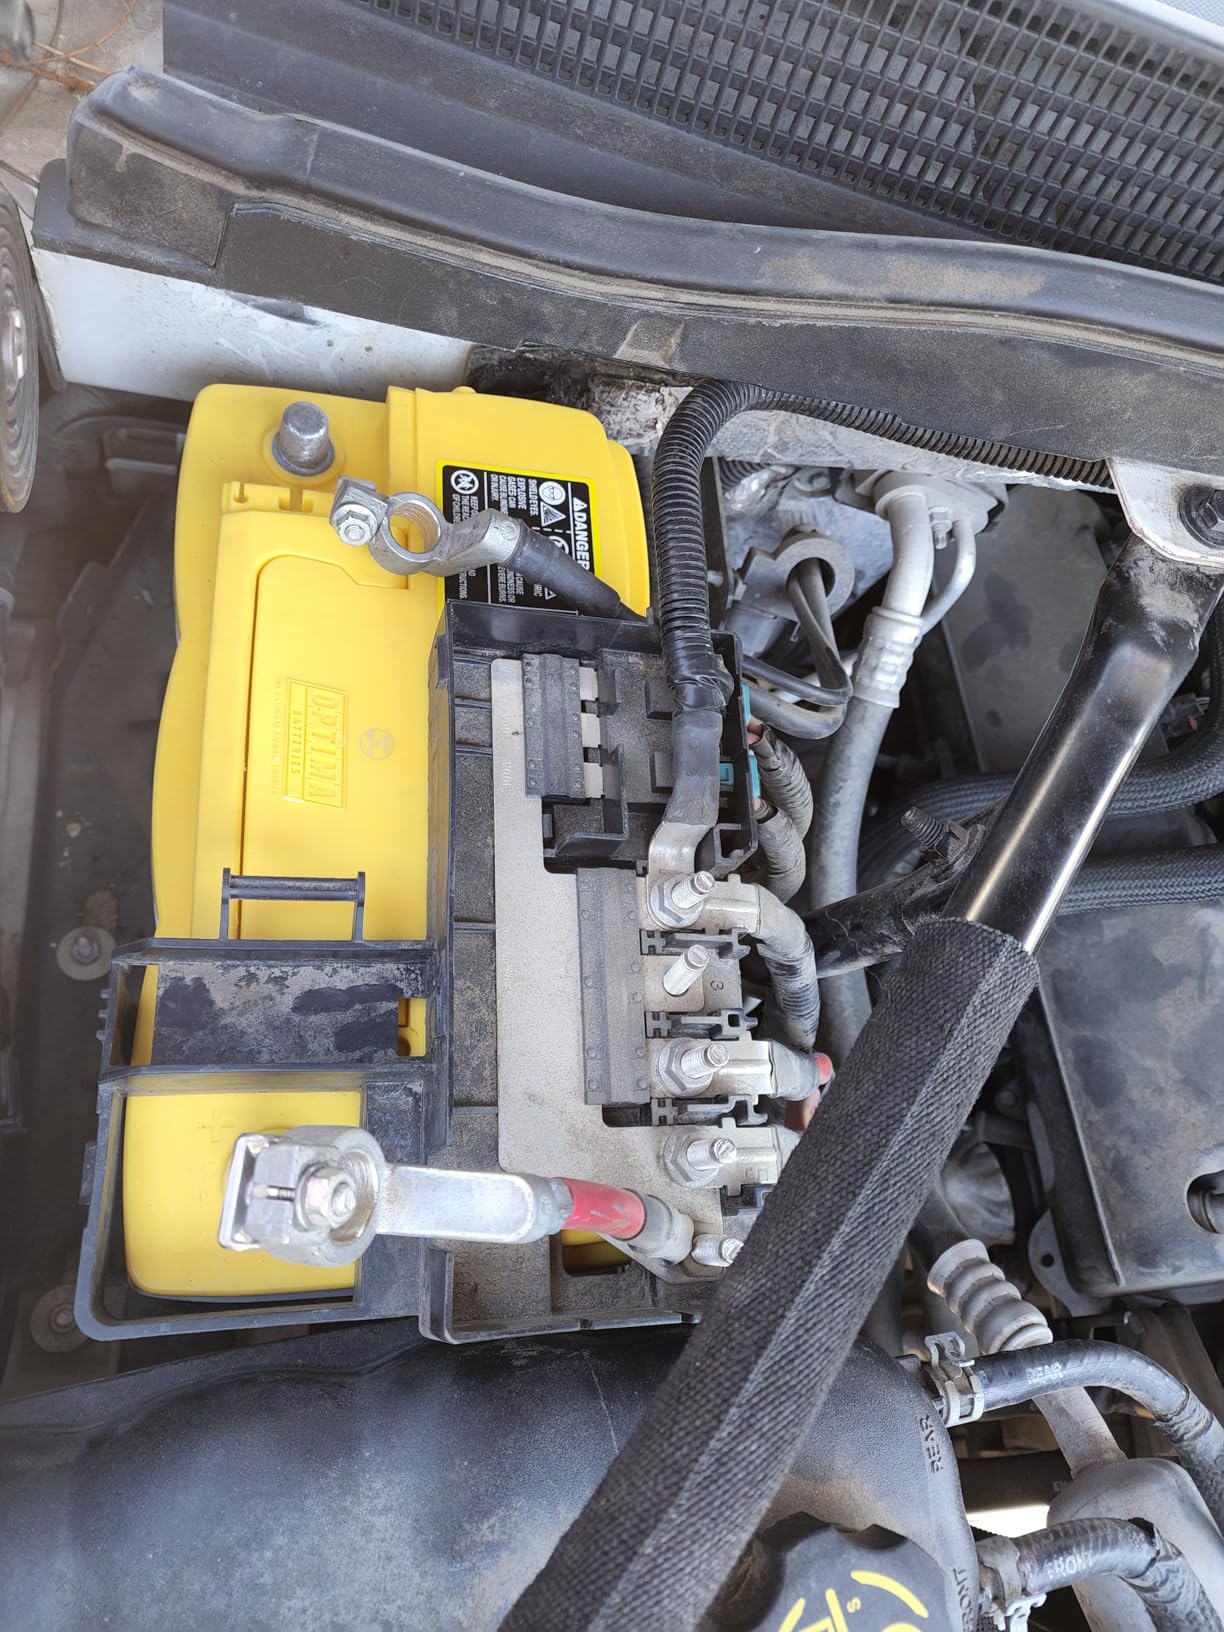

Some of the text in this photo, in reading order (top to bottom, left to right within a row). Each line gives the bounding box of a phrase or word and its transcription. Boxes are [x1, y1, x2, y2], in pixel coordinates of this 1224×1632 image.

[490, 474, 499, 482] OR
[499, 476, 508, 492] CAUSE
[508, 476, 517, 508] GASES CAN
[461, 496, 470, 506] THE
[517, 478, 527, 510] EXPLOSIVE
[528, 479, 539, 516] SHIELD EYES.
[508, 595, 516, 604] OR
[516, 577, 524, 595] CAUSE
[290, 710, 302, 775] BATTERIES
[309, 693, 339, 798] OPTIMA
[918, 1414, 944, 1474] REAR
[1043, 1551, 1095, 1580] FRONT
